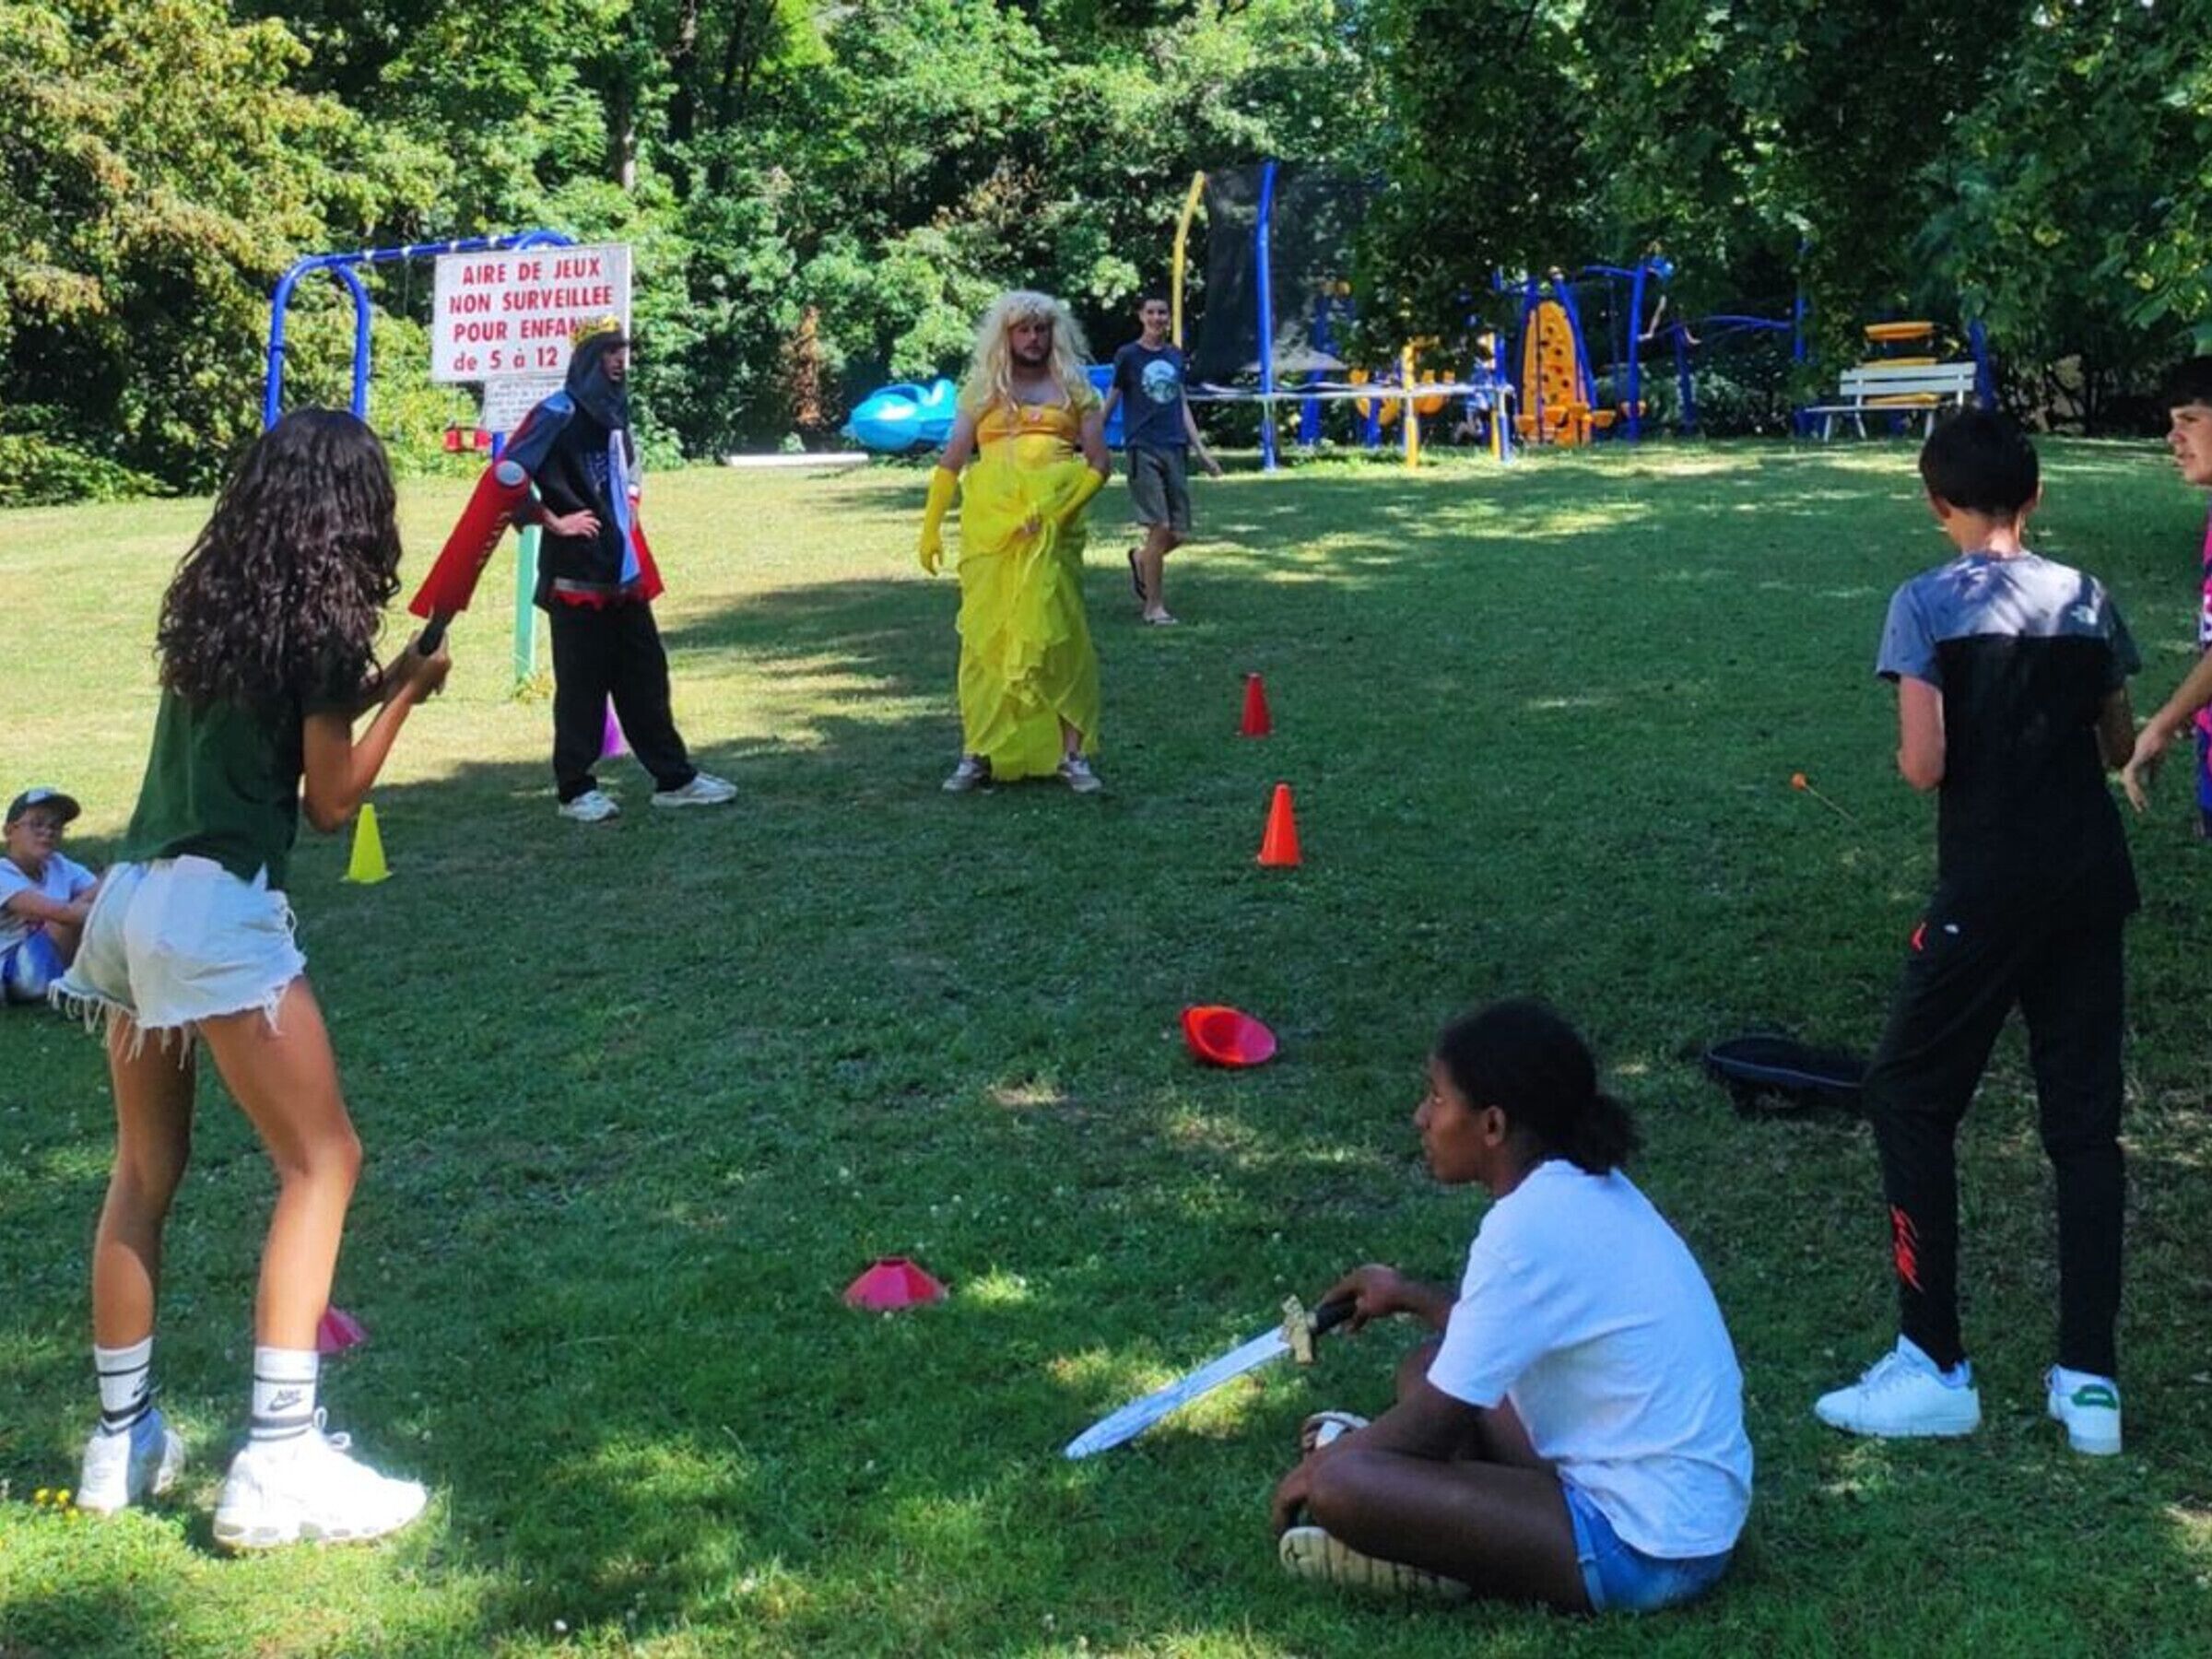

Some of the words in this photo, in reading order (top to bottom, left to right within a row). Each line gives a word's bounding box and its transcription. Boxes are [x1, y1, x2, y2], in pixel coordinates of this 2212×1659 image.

[463, 264, 507, 285] AIRE
[518, 262, 542, 281] DE
[555, 257, 601, 279] JEUX
[449, 294, 491, 314] NON
[502, 286, 613, 312] SURVEILLEE
[453, 323, 507, 343] POUR
[453, 352, 477, 371] de
[490, 350, 501, 369] 5
[537, 347, 559, 367] 12
